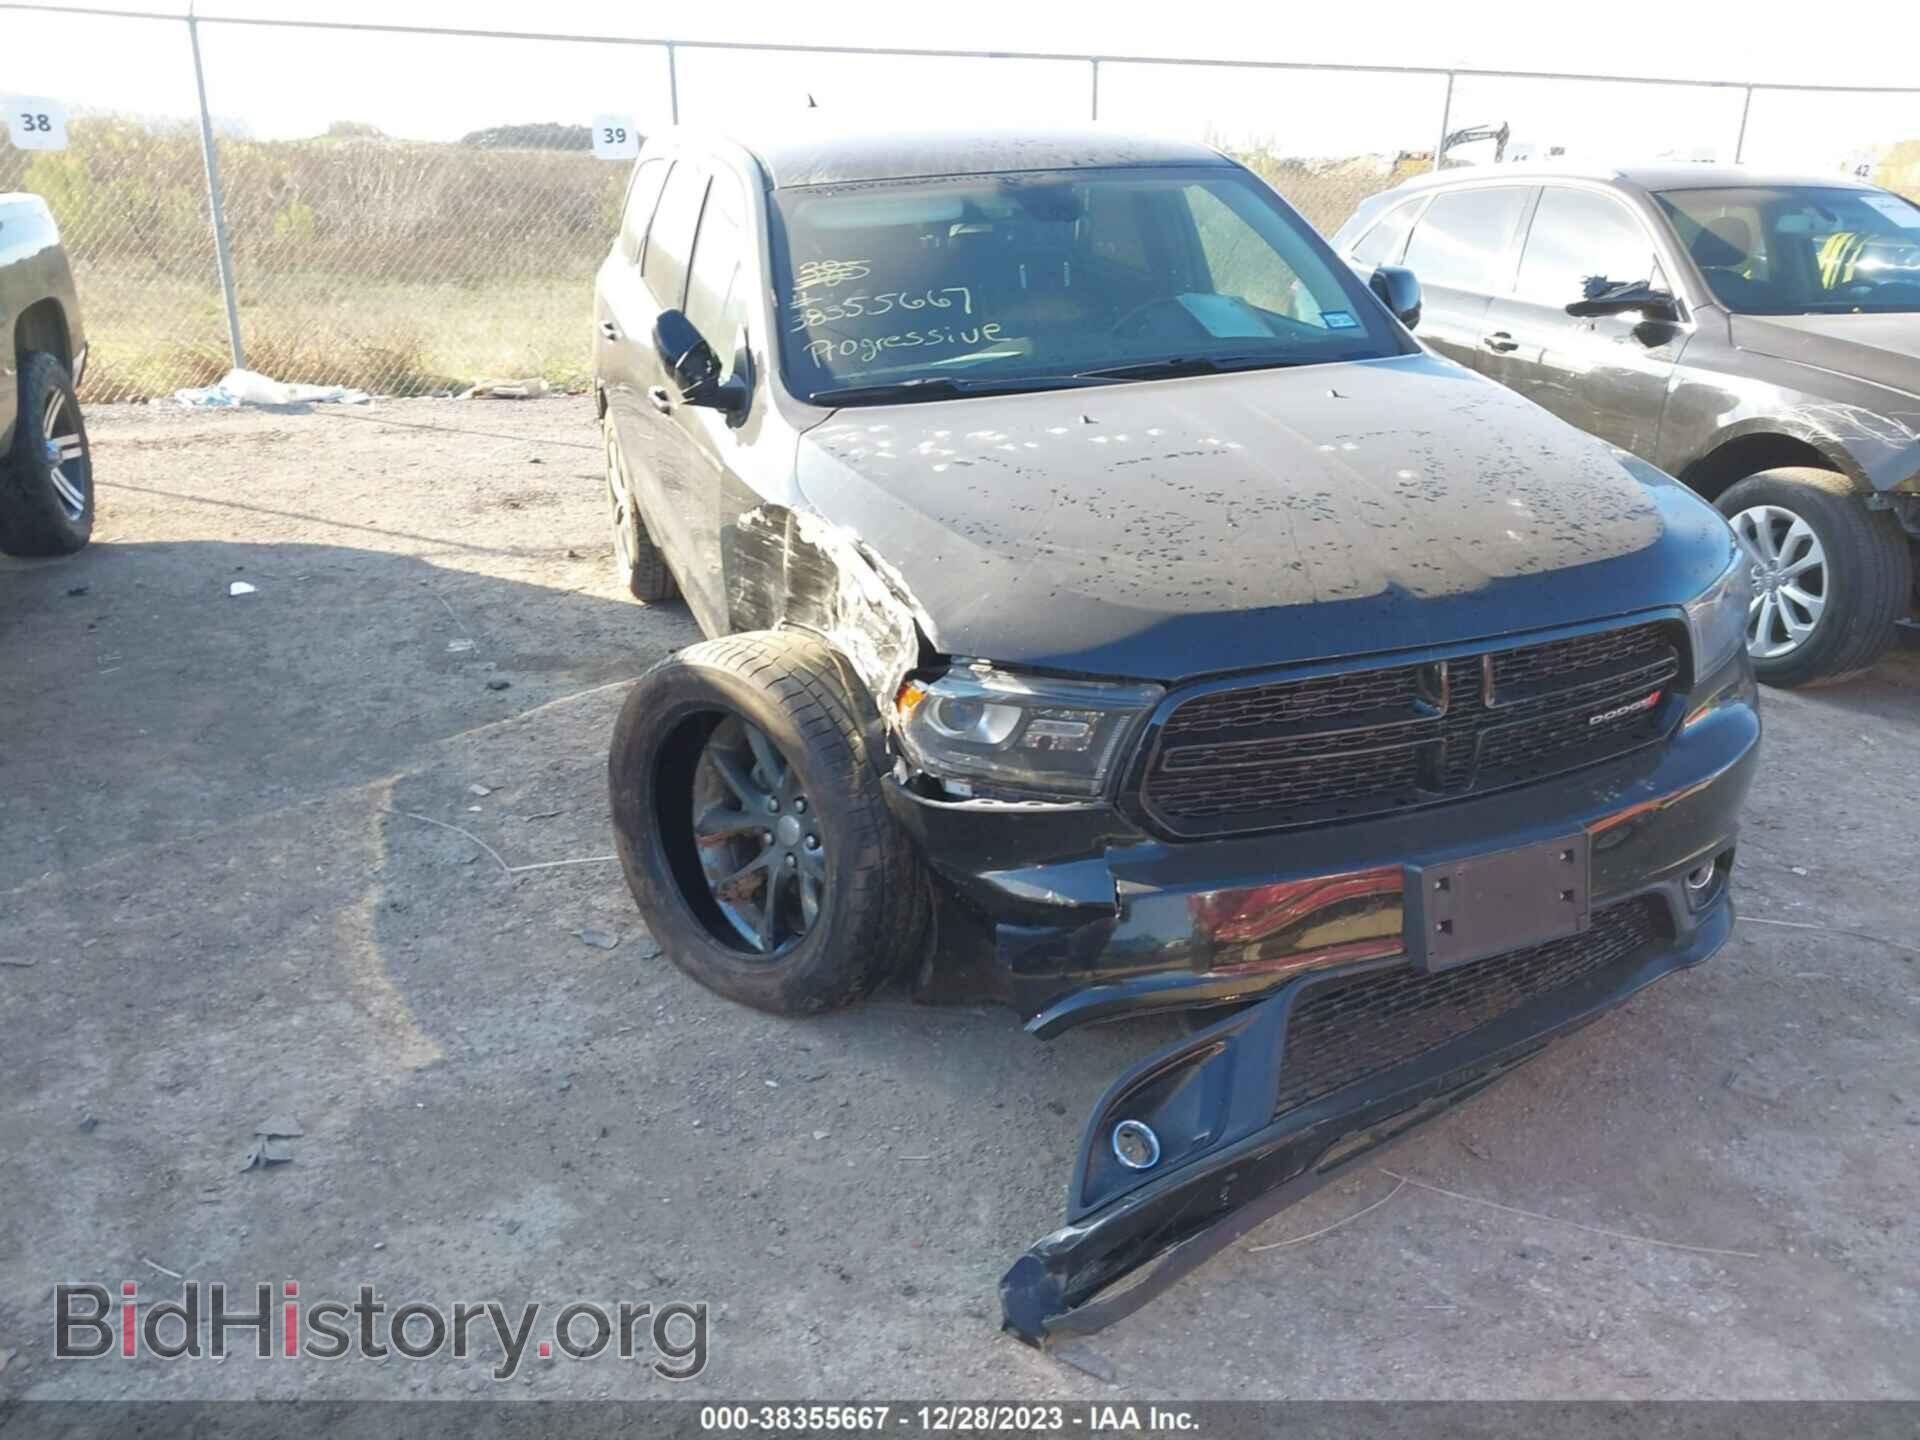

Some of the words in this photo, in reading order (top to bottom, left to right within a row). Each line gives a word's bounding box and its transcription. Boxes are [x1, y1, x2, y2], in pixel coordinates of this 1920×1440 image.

[20, 113, 52, 132] 38
[603, 127, 627, 144] 39
[1854, 163, 1871, 177] 42
[789, 286, 972, 333] 38355667
[802, 322, 1012, 368] Progressive
